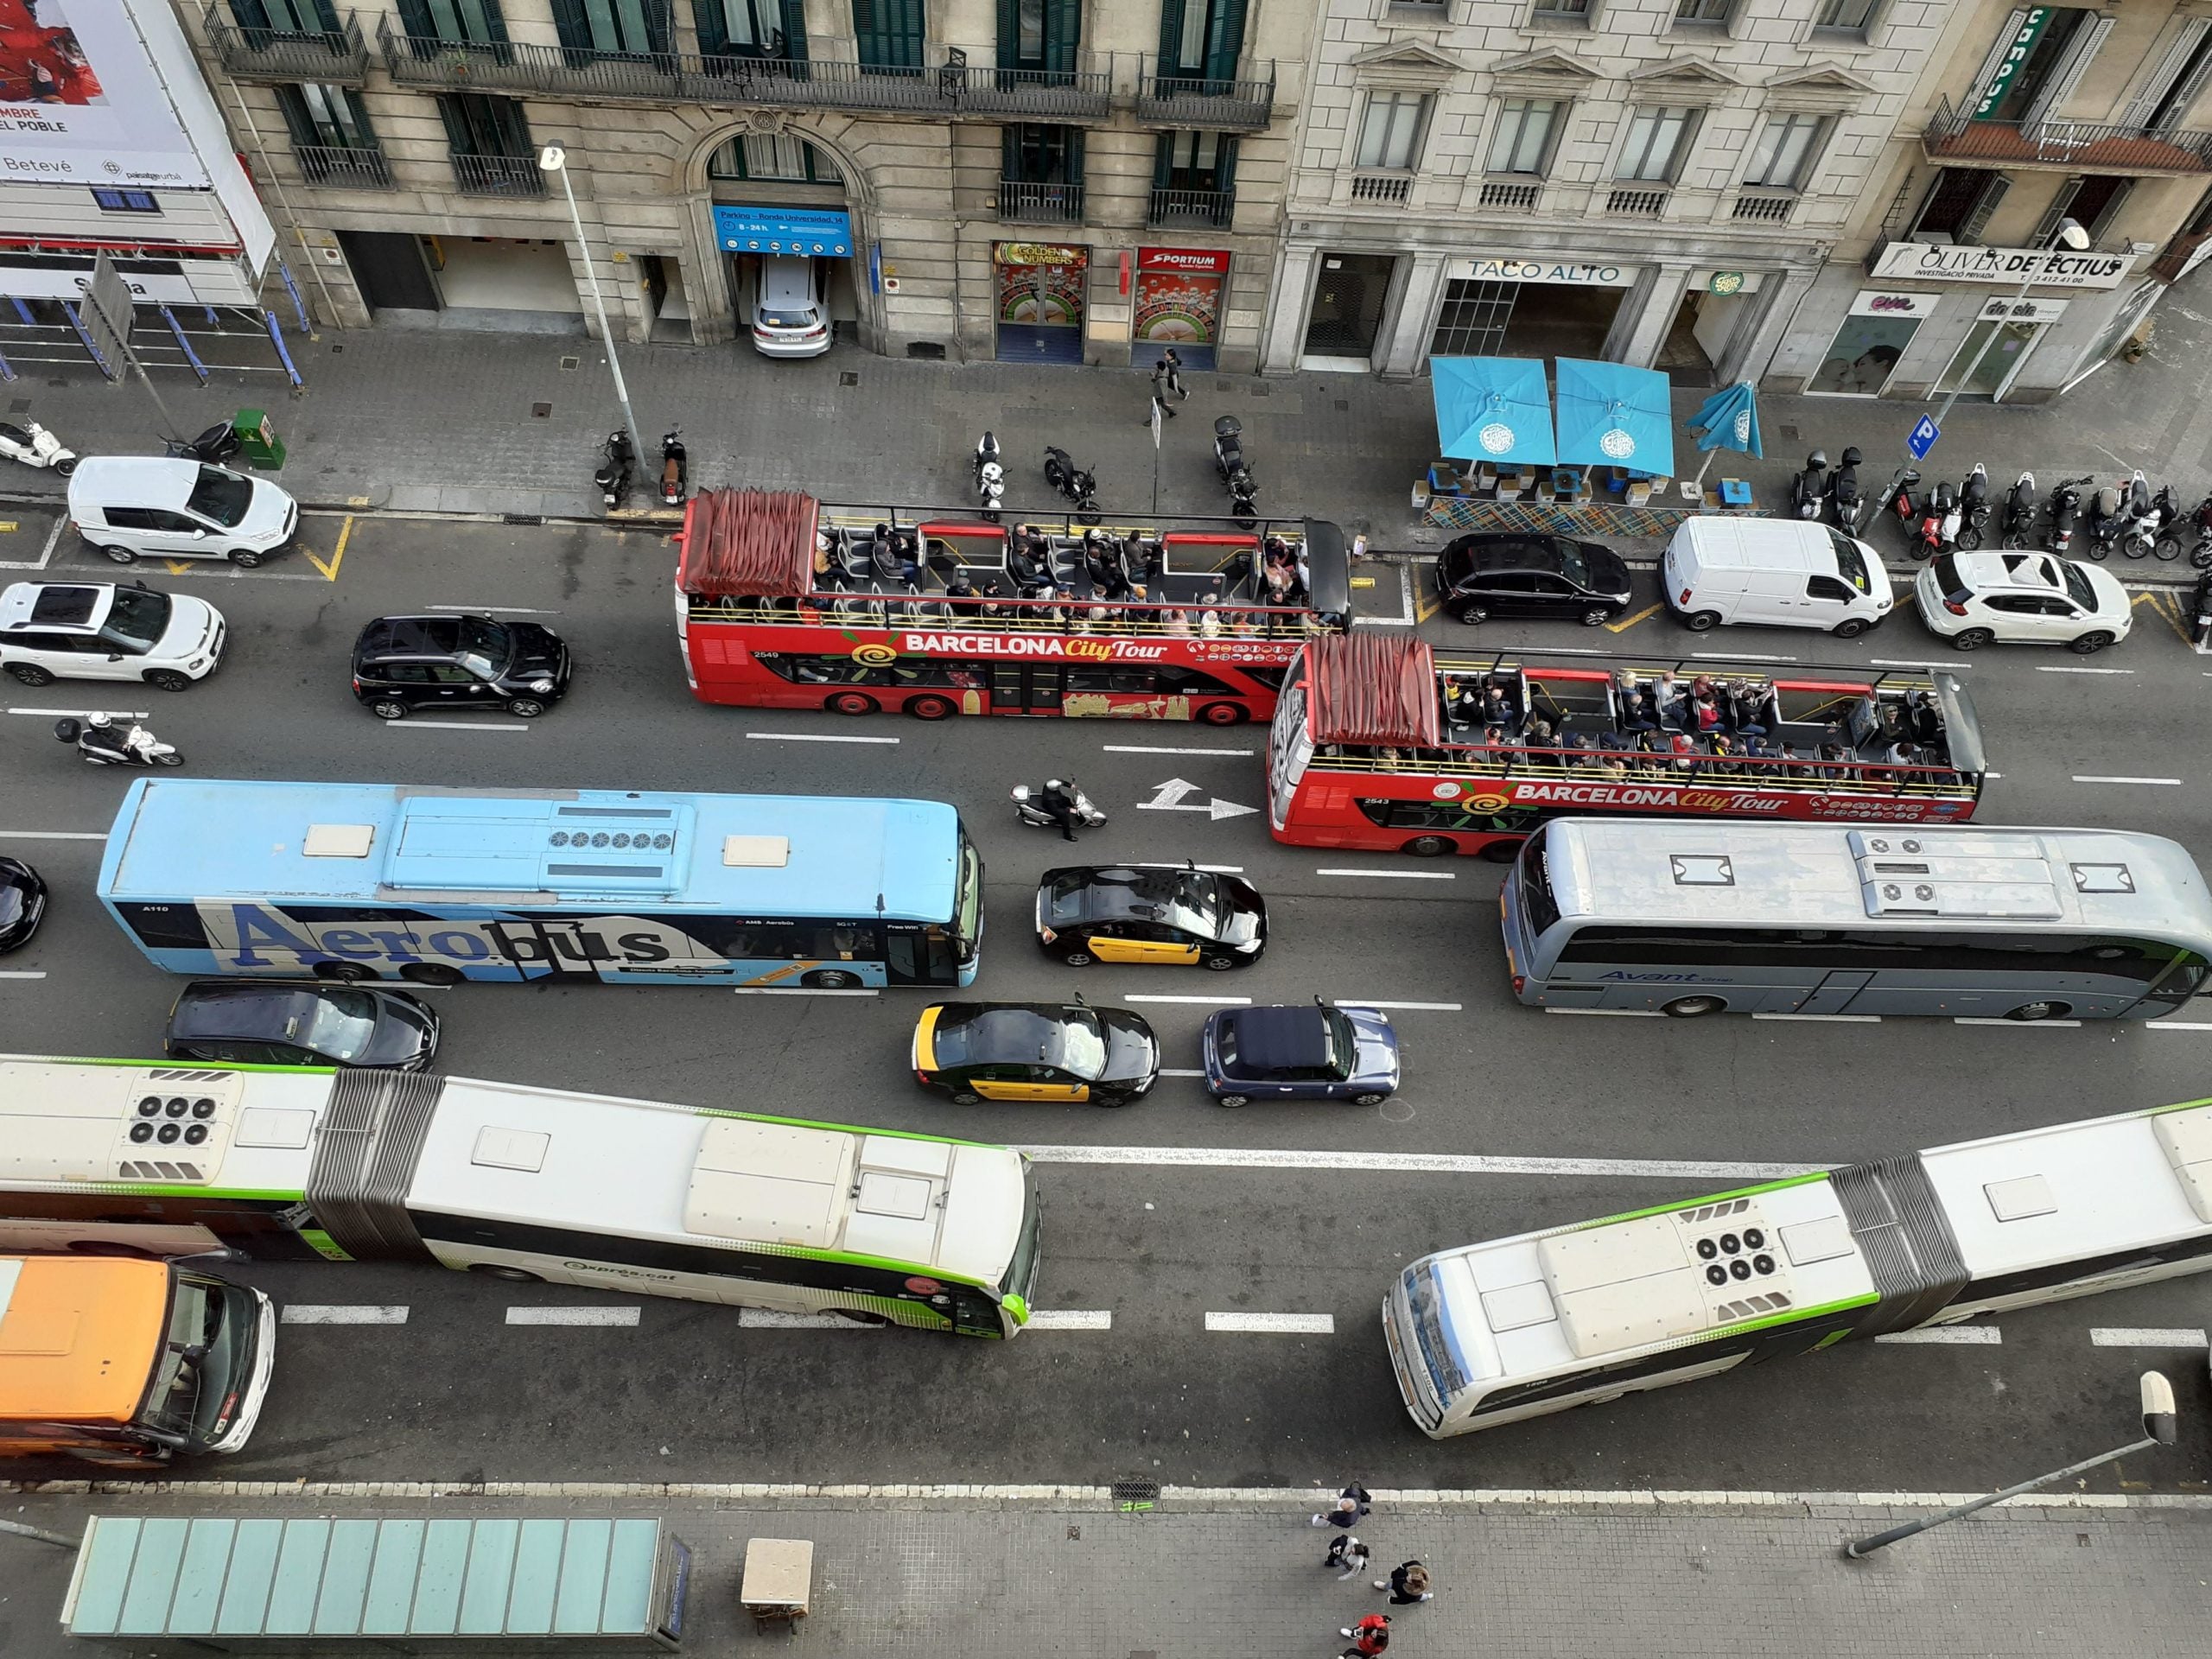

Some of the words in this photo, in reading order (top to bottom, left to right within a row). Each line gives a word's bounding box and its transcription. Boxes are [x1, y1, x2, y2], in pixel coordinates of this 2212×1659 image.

[17, 121, 68, 132] POBLE
[3, 157, 72, 173] Betevé
[721, 211, 750, 219] Parking
[1300, 222, 1310, 231] 12
[1020, 247, 1062, 257] GOLDEN
[1143, 252, 1215, 265] SPORTIUM
[1022, 255, 1073, 264] NUMBERS
[1921, 251, 2006, 271] OLIVER
[1468, 261, 1541, 278] TACO
[1546, 264, 1619, 282] ALTO
[1915, 270, 1964, 278] INVESTIGACIÓ
[1916, 419, 1934, 439] P
[906, 633, 1065, 656] BARCELONA
[1065, 639, 1114, 661] City
[1111, 640, 1168, 658] Tour
[1515, 785, 1678, 806] BARCELONA
[1679, 791, 1731, 811] City
[1730, 794, 1789, 810] Tour
[1541, 850, 1551, 885] Avant
[1598, 970, 1700, 982] Avant
[1421, 1368, 1434, 1392] 1506
